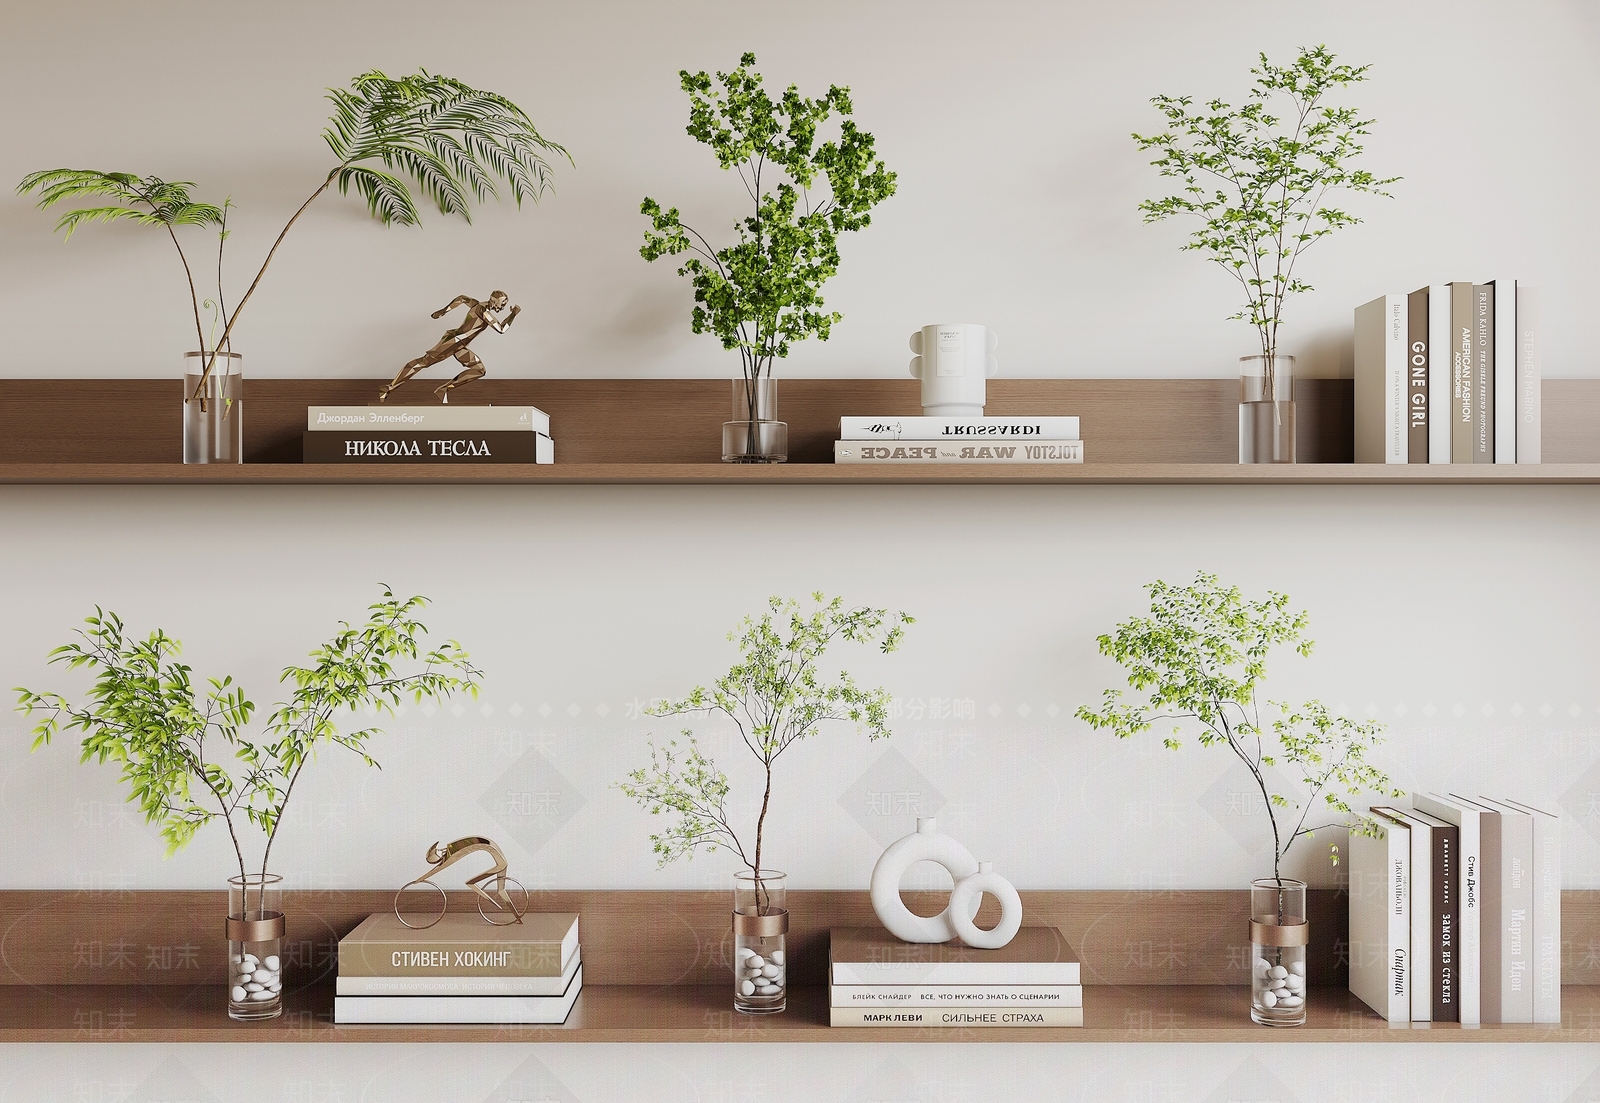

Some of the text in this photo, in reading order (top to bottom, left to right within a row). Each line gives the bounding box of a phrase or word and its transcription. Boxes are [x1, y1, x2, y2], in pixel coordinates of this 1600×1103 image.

[1393, 304, 1401, 341] Italo Calvino
[1479, 292, 1487, 316] FRIDA
[1479, 318, 1487, 346] KAHLO
[1411, 341, 1426, 428] GONE GIRL
[1454, 351, 1462, 399] ACCESSORIES
[1462, 327, 1471, 422] AMERICAN FASHION
[1524, 330, 1534, 423] STEPHEN MARINO
[317, 412, 425, 425] Джордан Элленберг
[345, 440, 491, 457] НИКОЛА ТЕСЛА
[1467, 856, 1475, 877] Стив
[1394, 858, 1403, 915] ДЖОВАНЬОЛИ
[1466, 878, 1475, 908] Джобс
[391, 951, 449, 967] СТИВЕН
[454, 951, 511, 967] ХОКИНГ
[1508, 908, 1526, 991] Мартин Иден
[1391, 948, 1407, 997] Спартак
[1442, 967, 1451, 1004] стекла
[863, 1013, 1044, 1023] МАРК ЛЕВИ СИЛЬНЕЕ СТРАХА
